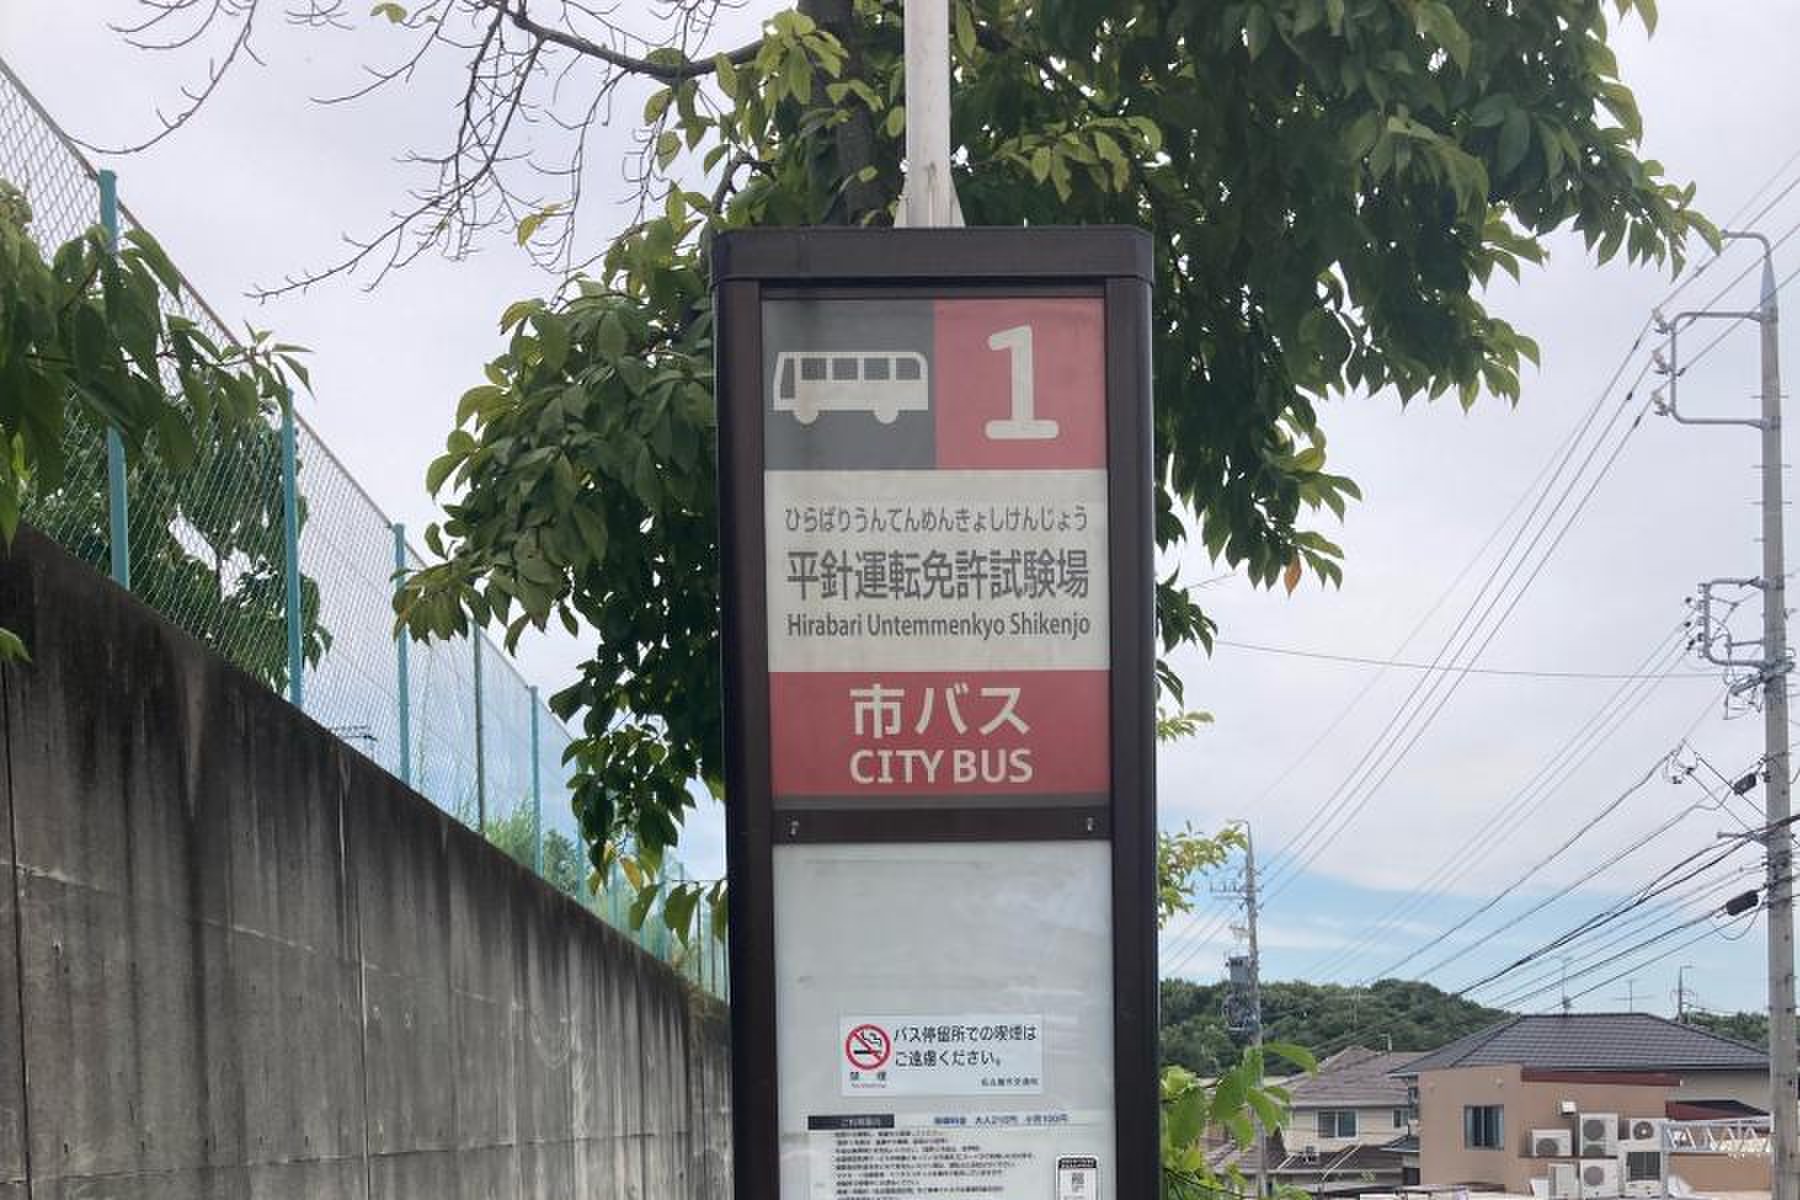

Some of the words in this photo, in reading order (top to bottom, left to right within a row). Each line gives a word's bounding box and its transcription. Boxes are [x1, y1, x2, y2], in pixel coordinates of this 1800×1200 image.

[984, 324, 1059, 440] 1
[784, 506, 1088, 533] ひらばりうんてんめんきょしけんじょう
[786, 549, 1090, 600] 平針運転免許試験場
[786, 612, 863, 637] Hirabari
[867, 611, 1005, 641] Untemmenkyo
[1009, 610, 1091, 640] Shikenjo
[849, 683, 1031, 739] 市バス
[849, 750, 944, 784] CITY
[953, 749, 1034, 784] BUS
[894, 1024, 1037, 1043] バス停留所での喫煙は
